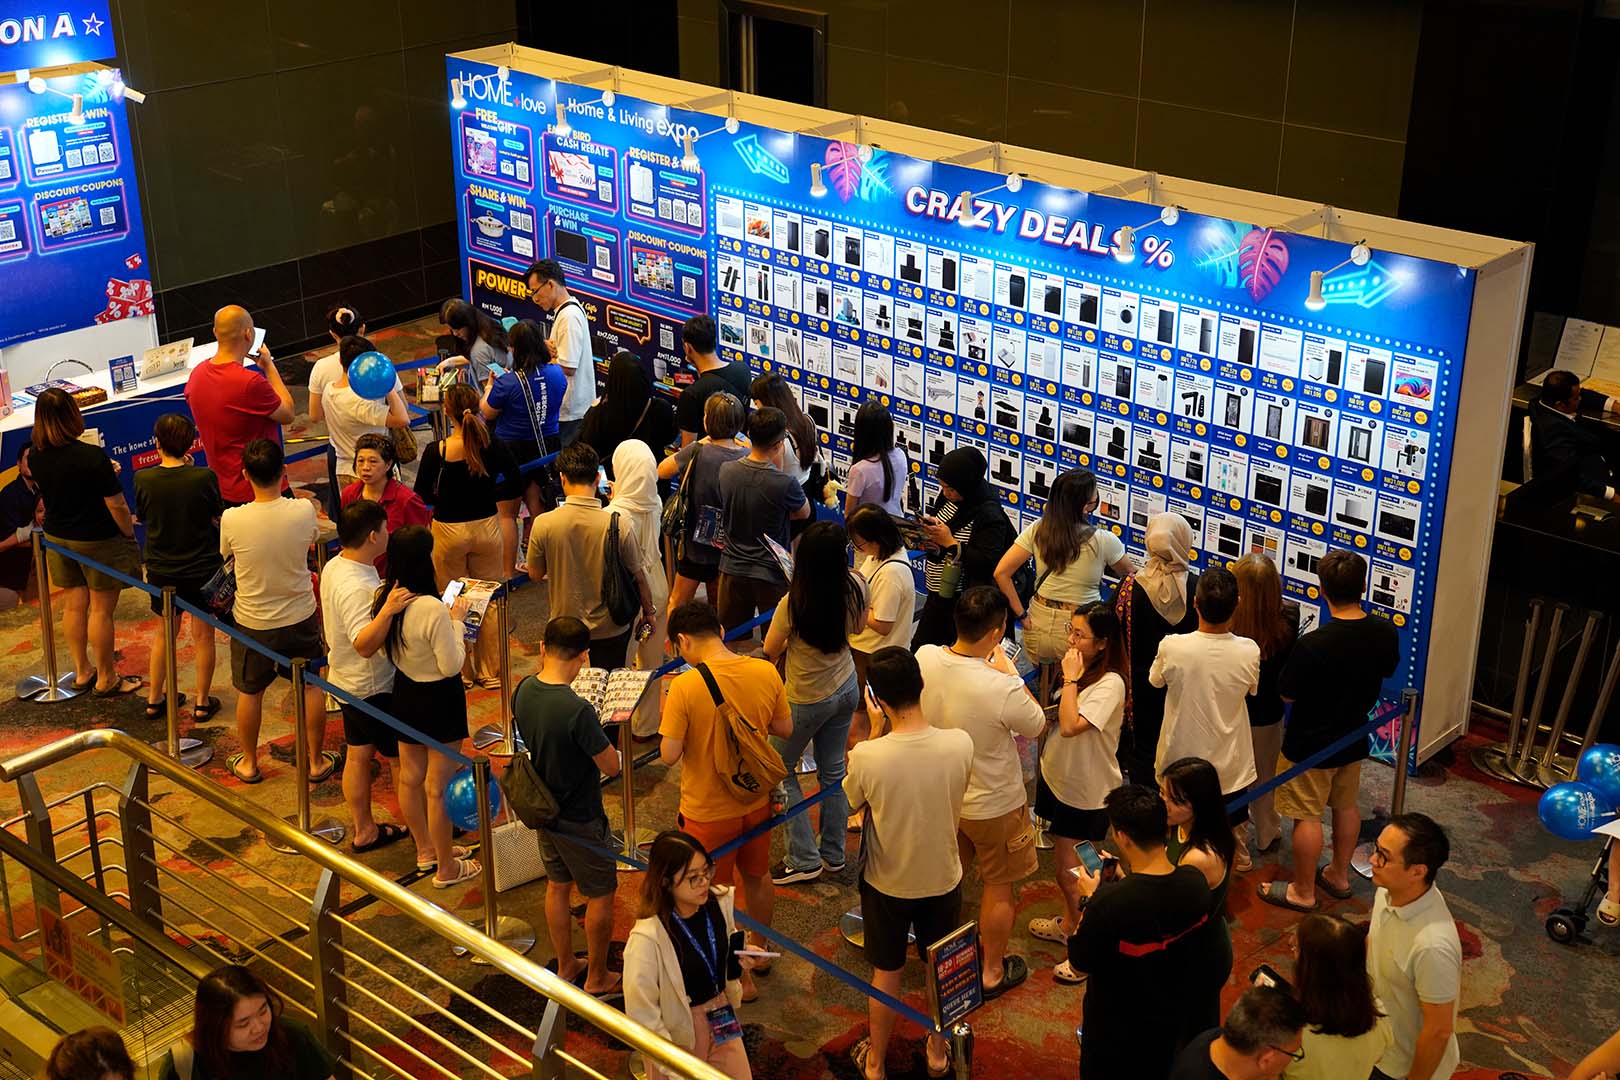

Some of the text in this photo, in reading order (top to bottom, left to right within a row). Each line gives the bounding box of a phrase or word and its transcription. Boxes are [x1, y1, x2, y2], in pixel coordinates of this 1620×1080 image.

[51, 13, 76, 39] A
[459, 71, 513, 107] HOME
[26, 113, 73, 128] REGISTE
[86, 108, 108, 120] WIN
[475, 107, 498, 123] FREE
[568, 98, 699, 147] Home & Living expo
[497, 121, 518, 136] GIFT
[573, 130, 591, 142] BIRD
[557, 137, 609, 158] CASH REBATE
[629, 147, 670, 167] REGISTER
[671, 156, 679, 168] &
[34, 178, 124, 200] DISCOUNT COUPONS
[469, 184, 499, 202] SHARE
[500, 192, 507, 203] &
[507, 193, 527, 208] WIN
[549, 204, 589, 222] PURCHASE
[554, 216, 577, 231] & WIN
[906, 186, 1174, 269] CRAZY DEALS %
[628, 230, 707, 259] DISCOUNT COUPONS
[113, 446, 127, 455] The
[128, 442, 147, 452] home
